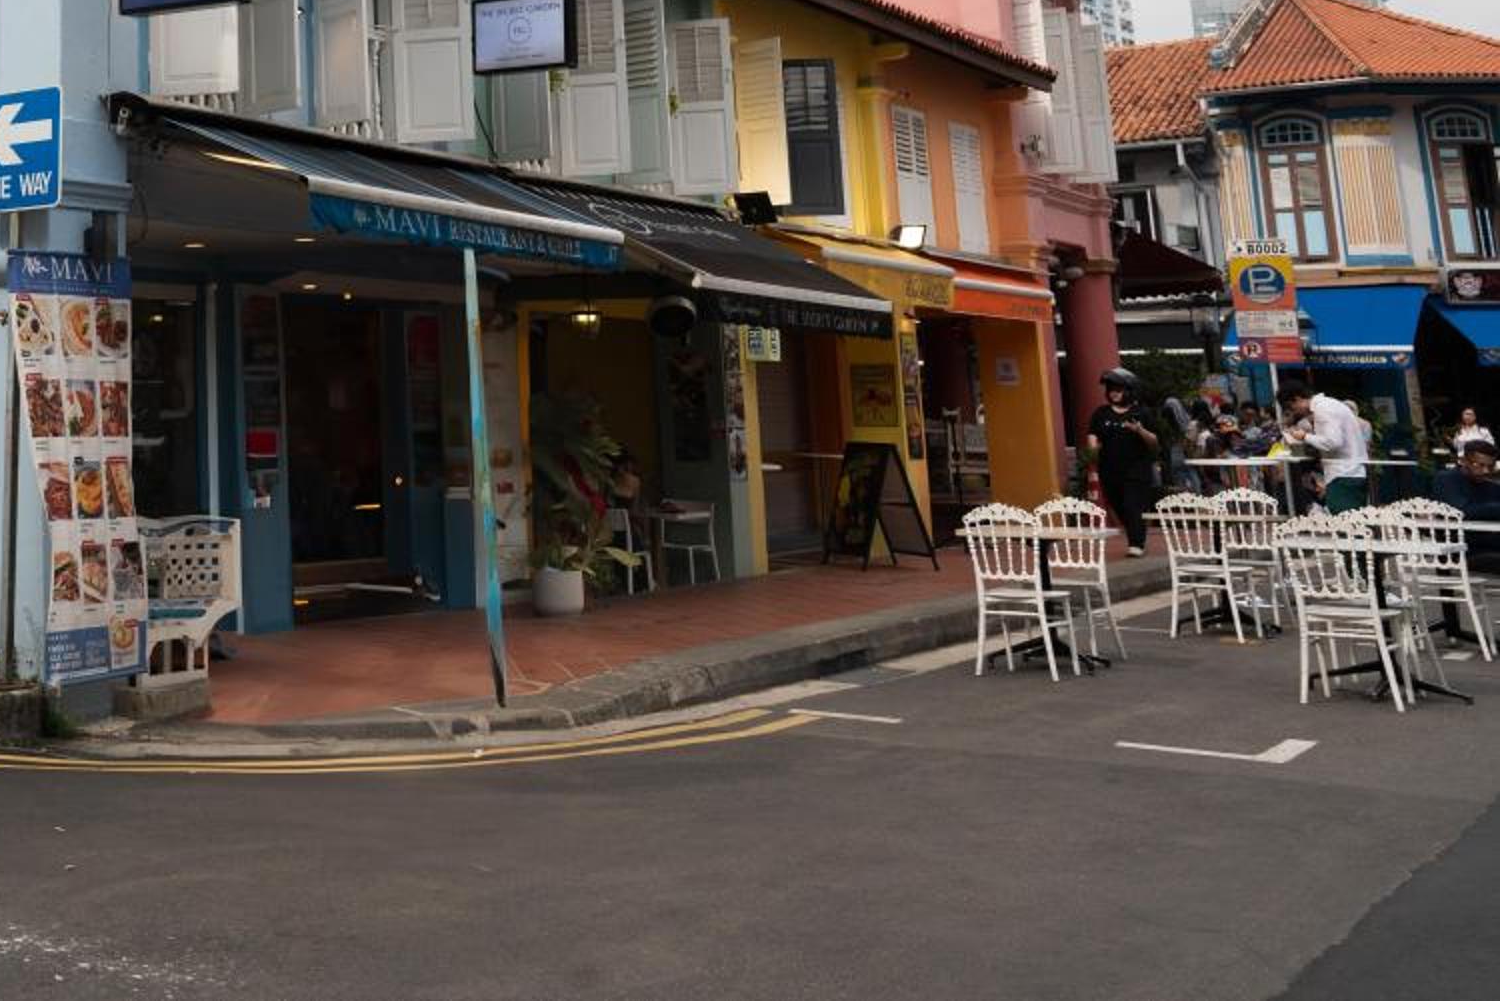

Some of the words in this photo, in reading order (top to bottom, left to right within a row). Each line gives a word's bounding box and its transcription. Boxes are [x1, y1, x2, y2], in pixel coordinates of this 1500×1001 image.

[19, 170, 53, 197] WAY
[375, 206, 441, 239] MAVI
[450, 220, 535, 252] RESTAURANT
[50, 255, 113, 284] MAVI
